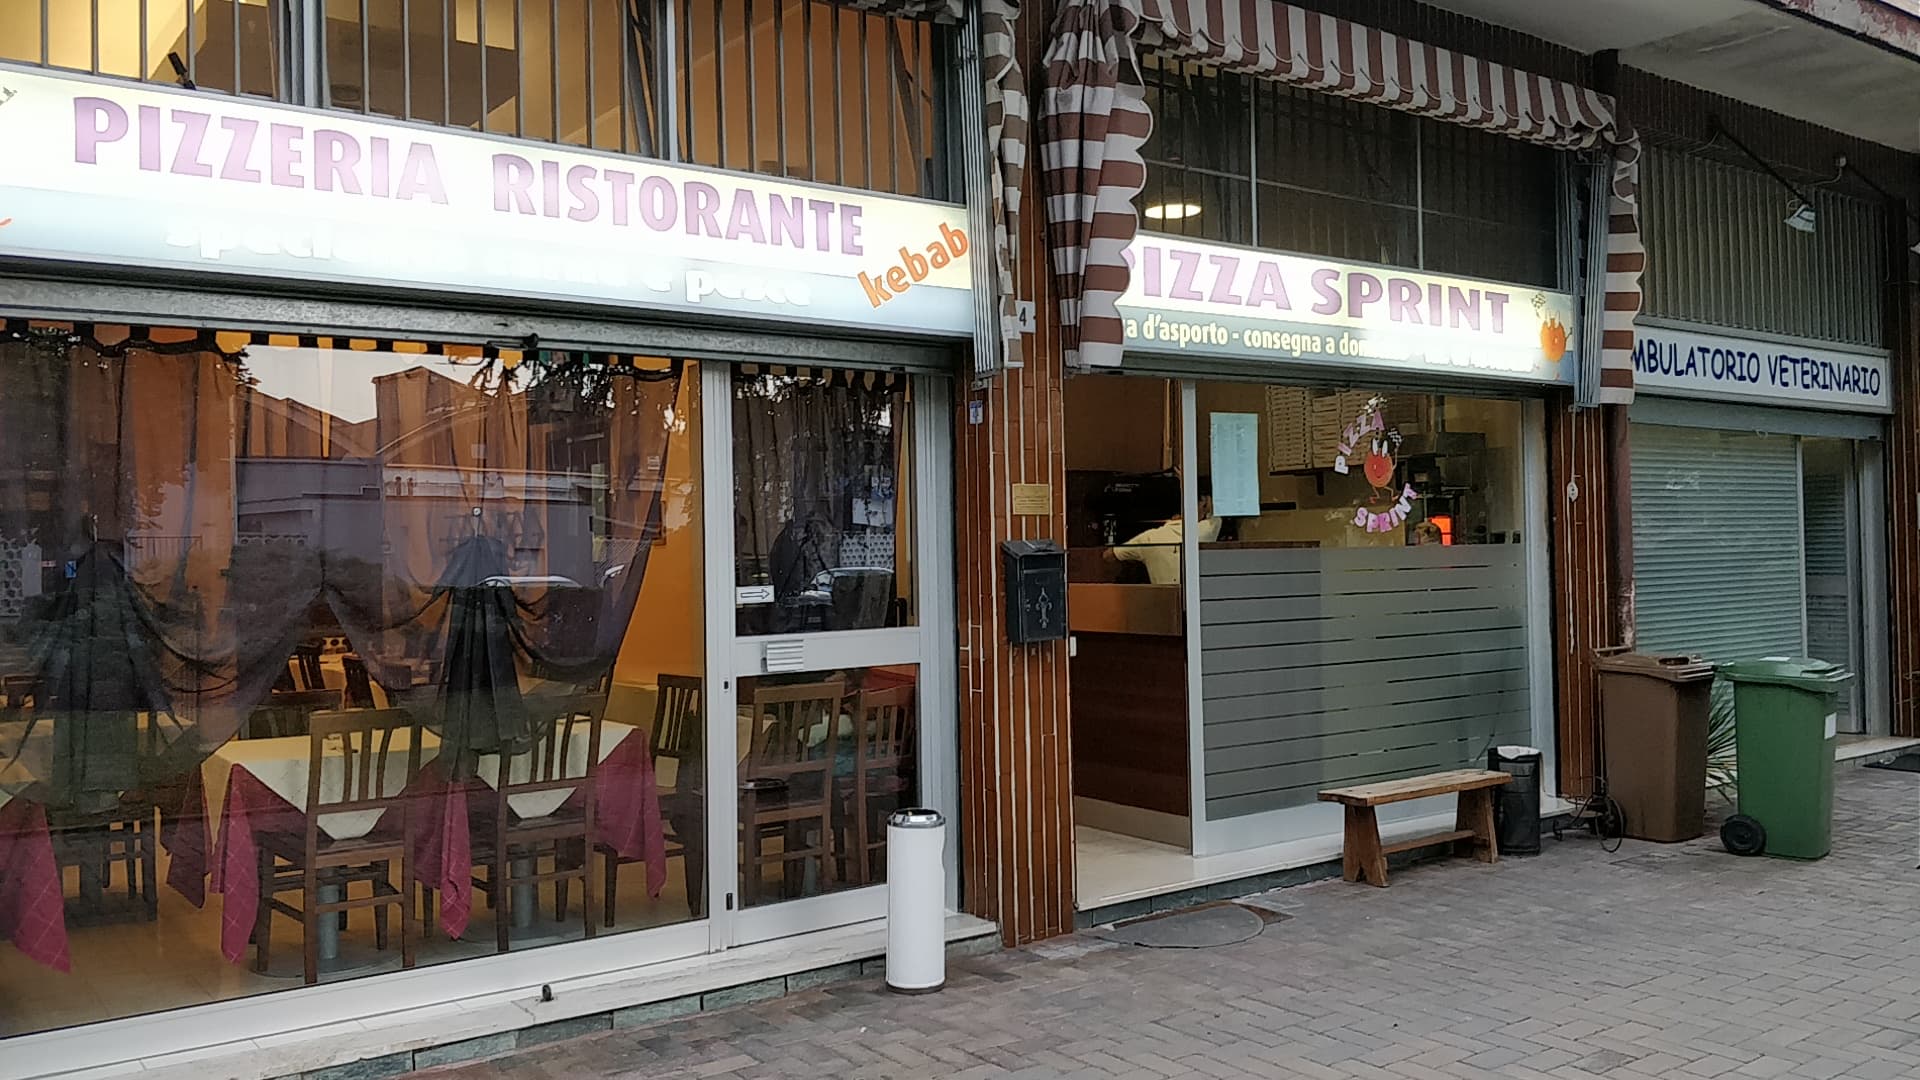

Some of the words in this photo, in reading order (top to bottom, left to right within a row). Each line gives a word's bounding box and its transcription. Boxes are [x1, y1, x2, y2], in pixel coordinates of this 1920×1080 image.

[73, 96, 449, 205] PIZZERIA
[491, 153, 864, 256] RISTORANTE
[857, 222, 968, 308] kebab
[1120, 246, 1292, 311] IZZA
[1311, 268, 1510, 334] SPRINT
[1018, 306, 1028, 327] 4
[1142, 312, 1228, 349] d'asporto
[1243, 328, 1322, 358] consegna
[1325, 336, 1336, 353] a
[1631, 338, 1761, 384] MBULATORIO
[1767, 354, 1881, 396] VETERINARIO
[1334, 410, 1385, 475] PIZZA
[1353, 482, 1418, 533] SPRINT
